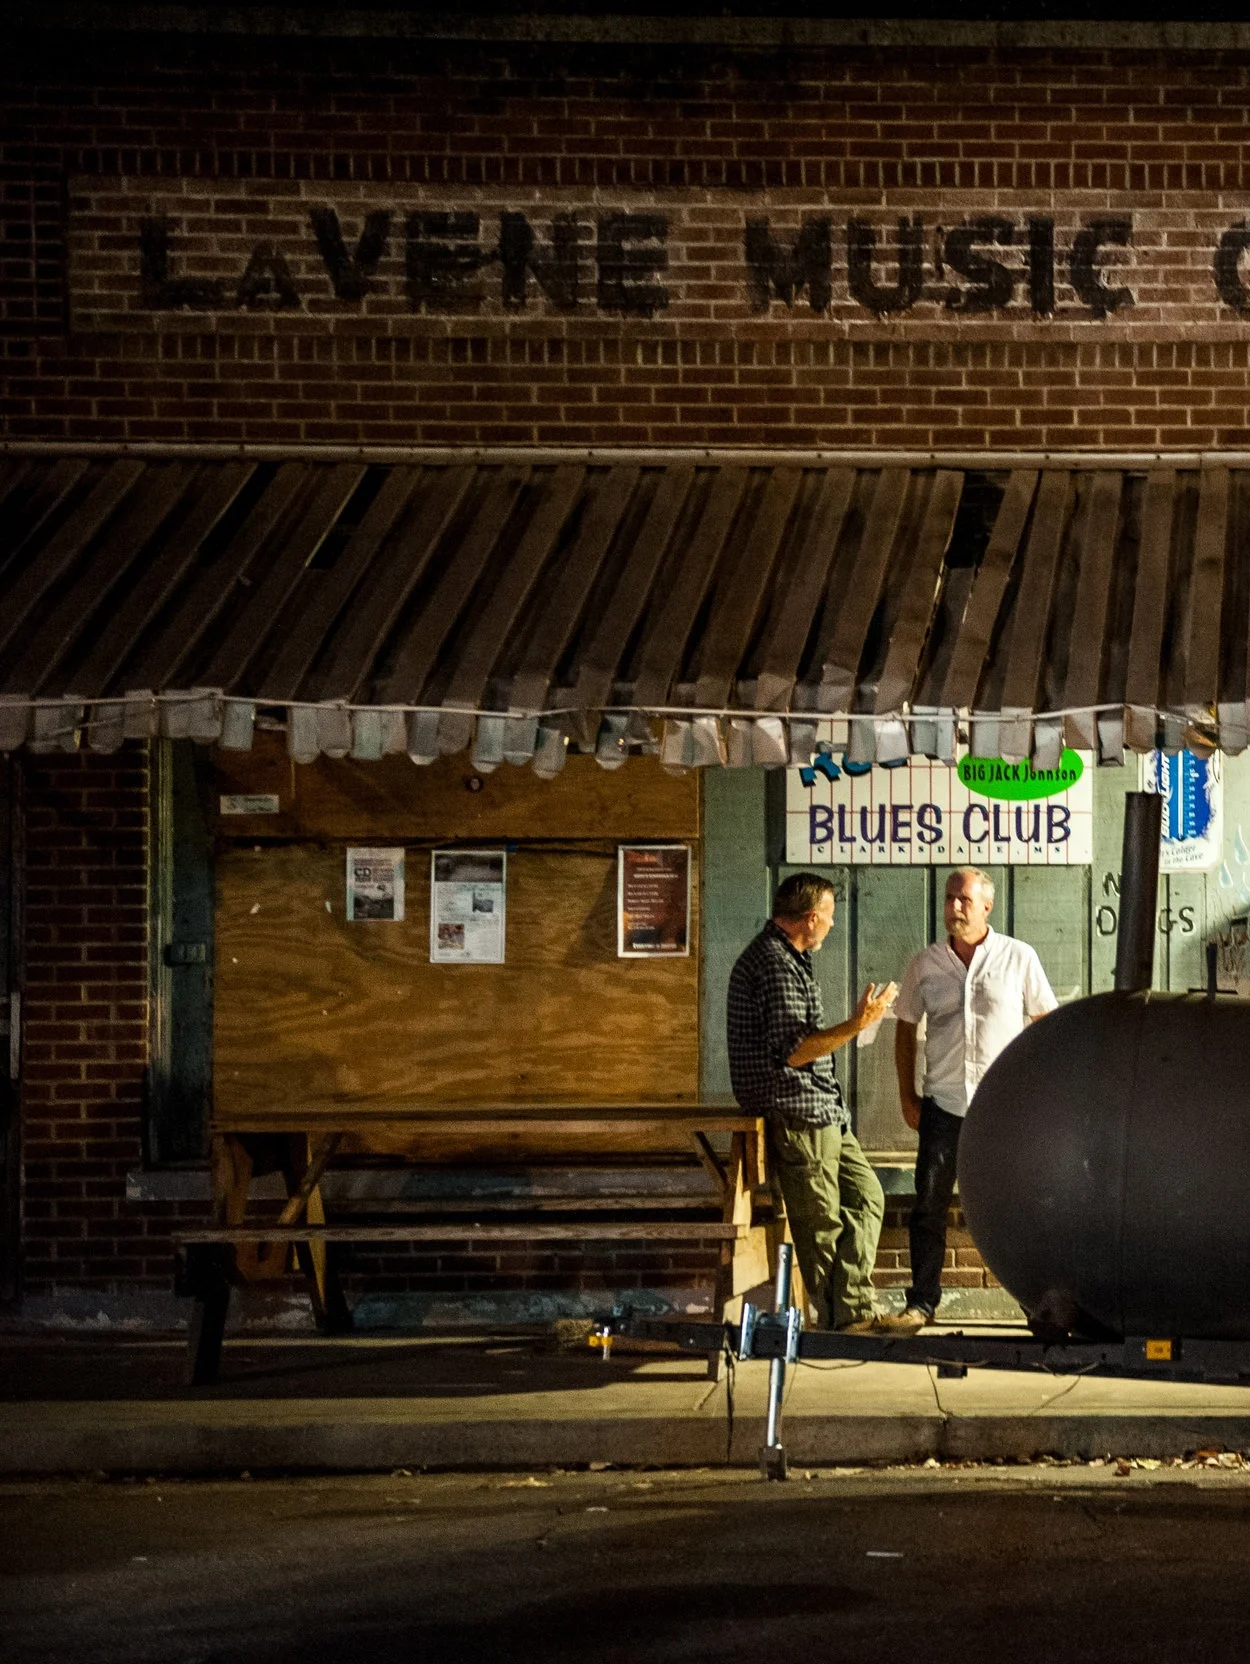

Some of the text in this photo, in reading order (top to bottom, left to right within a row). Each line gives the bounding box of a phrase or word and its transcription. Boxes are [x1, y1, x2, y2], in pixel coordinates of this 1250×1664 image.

[744, 212, 1136, 322] MUSIC
[962, 764, 987, 782] BIG
[988, 764, 1021, 784] JACK
[809, 803, 1072, 845] BLUES CLUB
[1103, 872, 1121, 898] N
[1096, 905, 1197, 937] DGS
